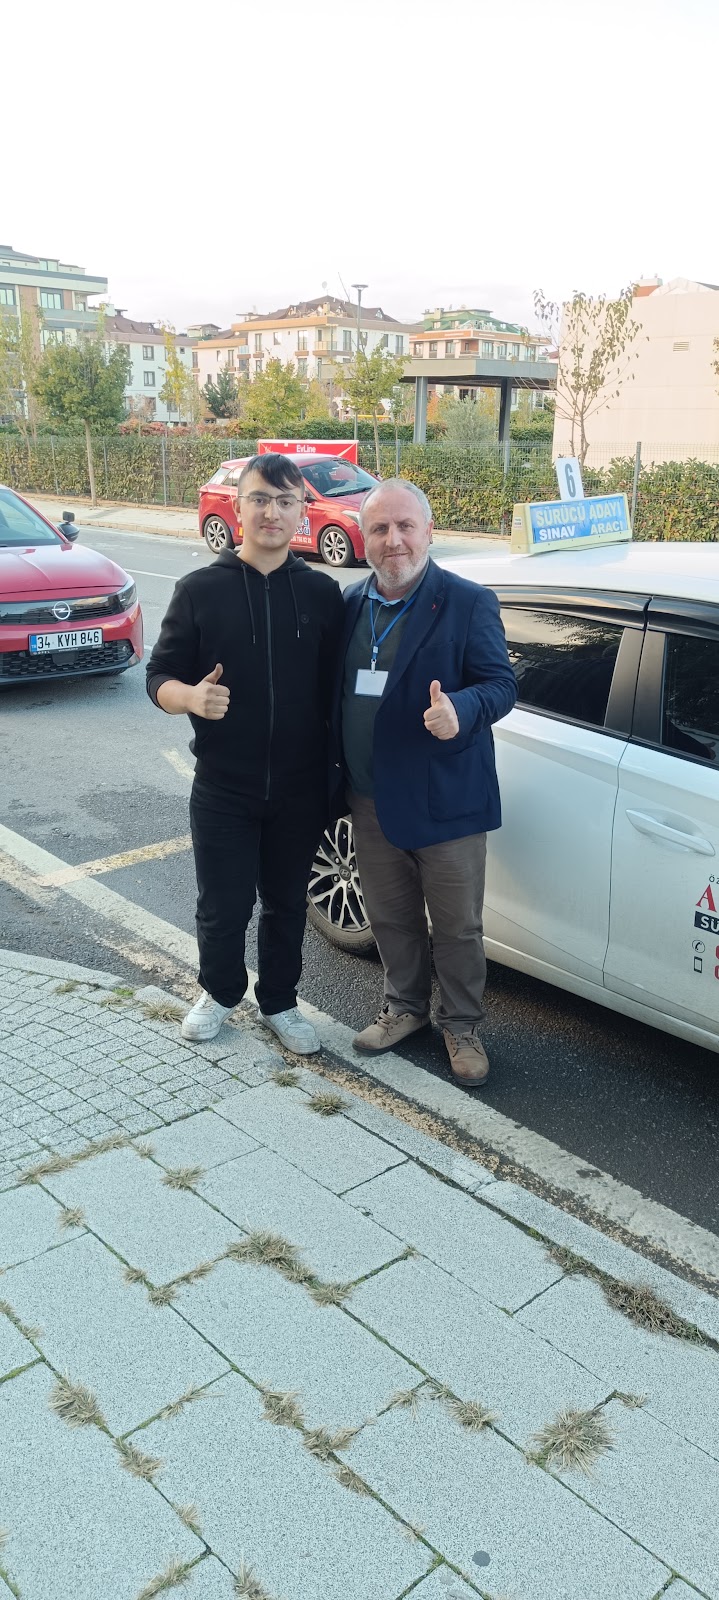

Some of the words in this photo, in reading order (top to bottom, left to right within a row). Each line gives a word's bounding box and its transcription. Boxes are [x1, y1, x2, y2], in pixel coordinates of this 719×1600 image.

[296, 444, 317, 453] EvLine
[564, 463, 576, 498] 6
[535, 502, 586, 527] SÜRÜCÜ
[589, 501, 622, 520] ADAYI
[539, 525, 576, 541] SINAV
[590, 520, 624, 535] ARACI
[37, 636, 50, 649] 34
[57, 633, 77, 647] KVH
[80, 631, 99, 645] 846
